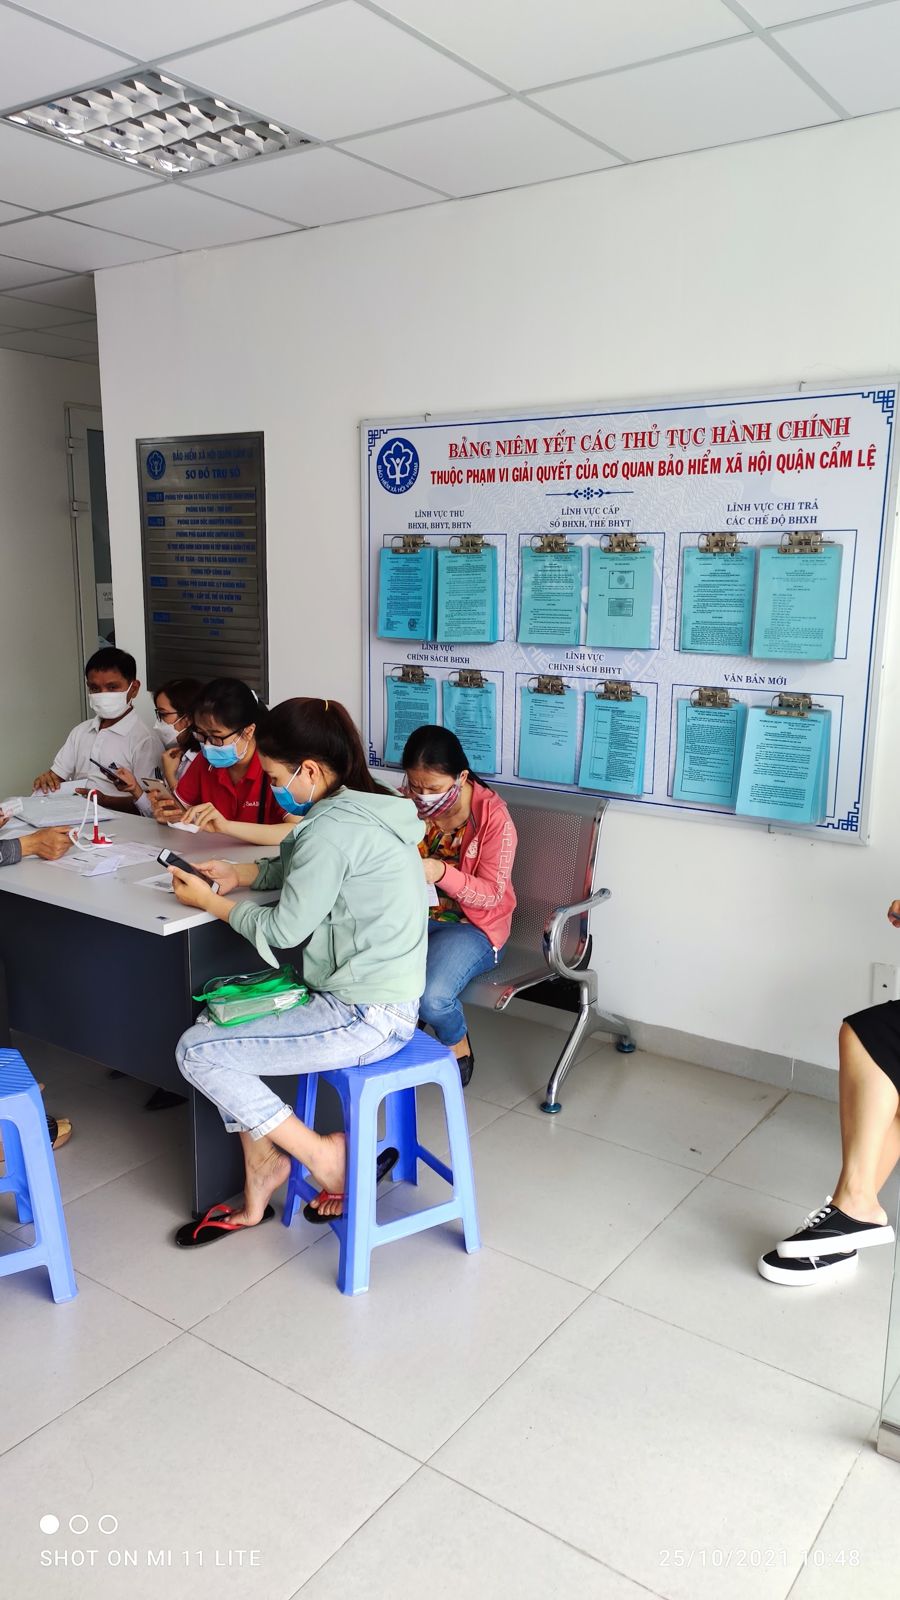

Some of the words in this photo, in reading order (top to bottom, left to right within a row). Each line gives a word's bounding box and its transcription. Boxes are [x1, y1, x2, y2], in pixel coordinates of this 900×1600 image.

[448, 436, 492, 459] BẢNG
[496, 436, 538, 457] NIÊM
[542, 429, 576, 454] YẾT
[580, 429, 616, 452] CÁC
[621, 423, 661, 449] THỦ
[667, 427, 706, 451] TỤC
[711, 420, 772, 444] HÀNH
[777, 414, 851, 441] CHÍNH
[430, 466, 464, 487] THUỘC
[466, 468, 496, 487] PHẠM
[499, 467, 509, 483] VI
[511, 461, 533, 482] GIẢI
[536, 458, 572, 484] QUYẾT
[575, 457, 599, 479] CỦA
[602, 460, 620, 479] CƠ
[621, 461, 654, 481] QUAN
[658, 453, 684, 476] BẢO
[688, 450, 722, 475] HIỂM
[725, 452, 743, 474] XÃ
[748, 450, 772, 476] HỘI
[776, 448, 815, 476] QUẬN
[819, 441, 853, 469] CẨM
[857, 444, 877, 470] LỆ
[561, 506, 581, 516] LĨNH
[583, 507, 601, 516] VỰC
[602, 504, 620, 515] CẤP
[727, 502, 751, 512] LĨNH
[754, 502, 774, 513] VỰC
[777, 502, 795, 511] CHI
[798, 498, 819, 510] TRẢ
[414, 510, 432, 518] LĨNH
[433, 510, 448, 519] VỰC
[449, 510, 465, 518] THU
[726, 515, 746, 526] CÁC
[748, 514, 769, 525] CHẾ
[771, 514, 786, 526] ĐỘ
[788, 515, 818, 525] BHXH
[562, 520, 587, 528] BHXH,
[588, 517, 606, 528] THẺ
[608, 519, 631, 527] BHYT
[407, 653, 429, 661] CHÍNH
[430, 655, 449, 663] SÁCH
[450, 656, 470, 664] BHXH
[565, 651, 586, 660] LĨNH
[587, 653, 605, 663] VỰC
[548, 663, 574, 672] CHÍNH
[576, 665, 598, 673] SÁCH
[599, 667, 622, 675] BHYT
[724, 674, 743, 683] VĂN
[745, 673, 765, 684] BẢN
[767, 676, 787, 686] MỚI
